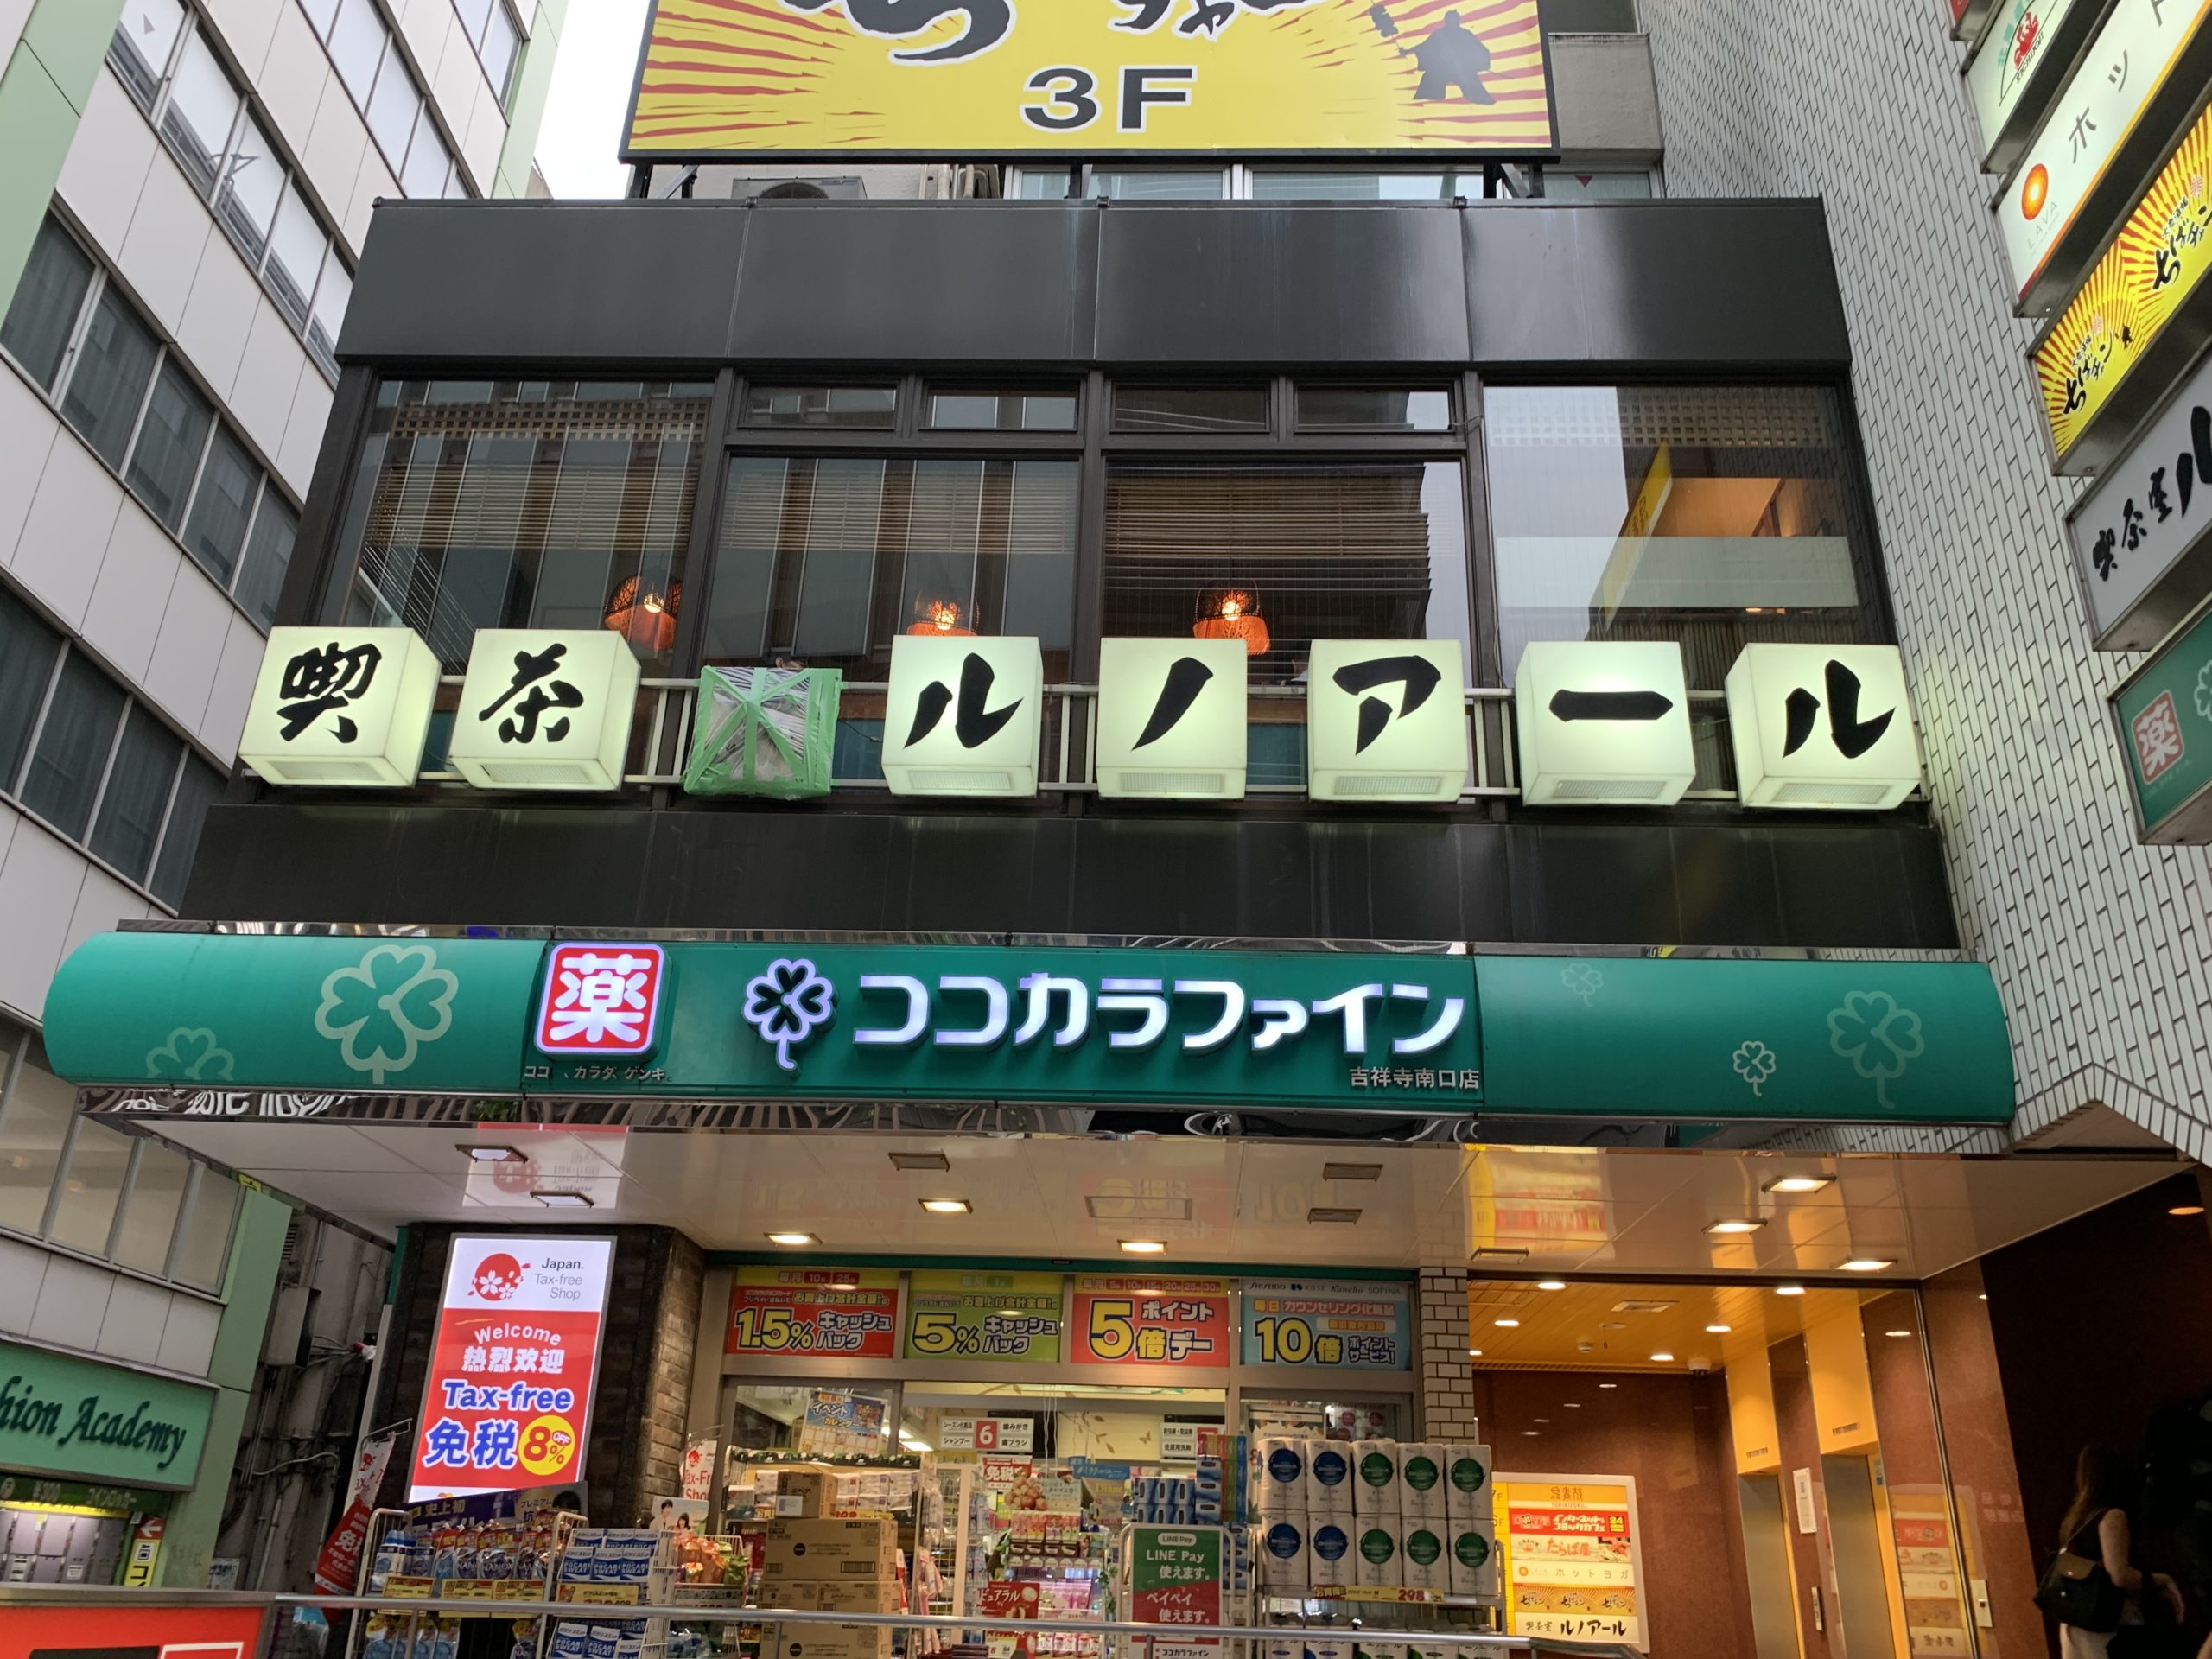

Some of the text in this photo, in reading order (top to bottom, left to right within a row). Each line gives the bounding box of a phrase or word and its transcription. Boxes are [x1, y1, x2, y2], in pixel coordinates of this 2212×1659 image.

[1022, 67, 1195, 131] 3F
[2027, 200, 2057, 250] LAVA
[2136, 699, 2180, 776] 薬
[549, 953, 651, 1043] 薬
[854, 972, 1465, 1055] ココカラファイン
[1350, 1066, 1479, 1089] 吉祥寺南口店
[541, 1257, 584, 1272] Japan.
[534, 1273, 583, 1286] Tax-free
[550, 1287, 581, 1301] Shop
[817, 1311, 892, 1332] キャッシュ
[1141, 1300, 1214, 1322] ポイント
[474, 1322, 562, 1346] Welcome
[736, 1307, 814, 1352] 1.5%
[912, 1312, 981, 1355] 5%
[982, 1315, 1058, 1336] キャッシュ
[817, 1331, 865, 1351] バック
[982, 1335, 1031, 1354] バック
[1348, 1335, 1395, 1351] ポイント
[442, 1380, 573, 1411] Tax-free
[58, 1395, 188, 1471] Academy
[423, 1419, 517, 1468] 免税
[552, 1431, 571, 1446] OFF
[979, 1425, 994, 1446] 6
[1146, 1549, 1205, 1564] LINE Pay
[1159, 1565, 1210, 1580] 使えます。
[1556, 1568, 1629, 1580] ホットヨガ
[1398, 1589, 1426, 1601] 298
[1159, 1608, 1210, 1624] 使えます。
[1560, 1618, 1627, 1637] ルノアール
